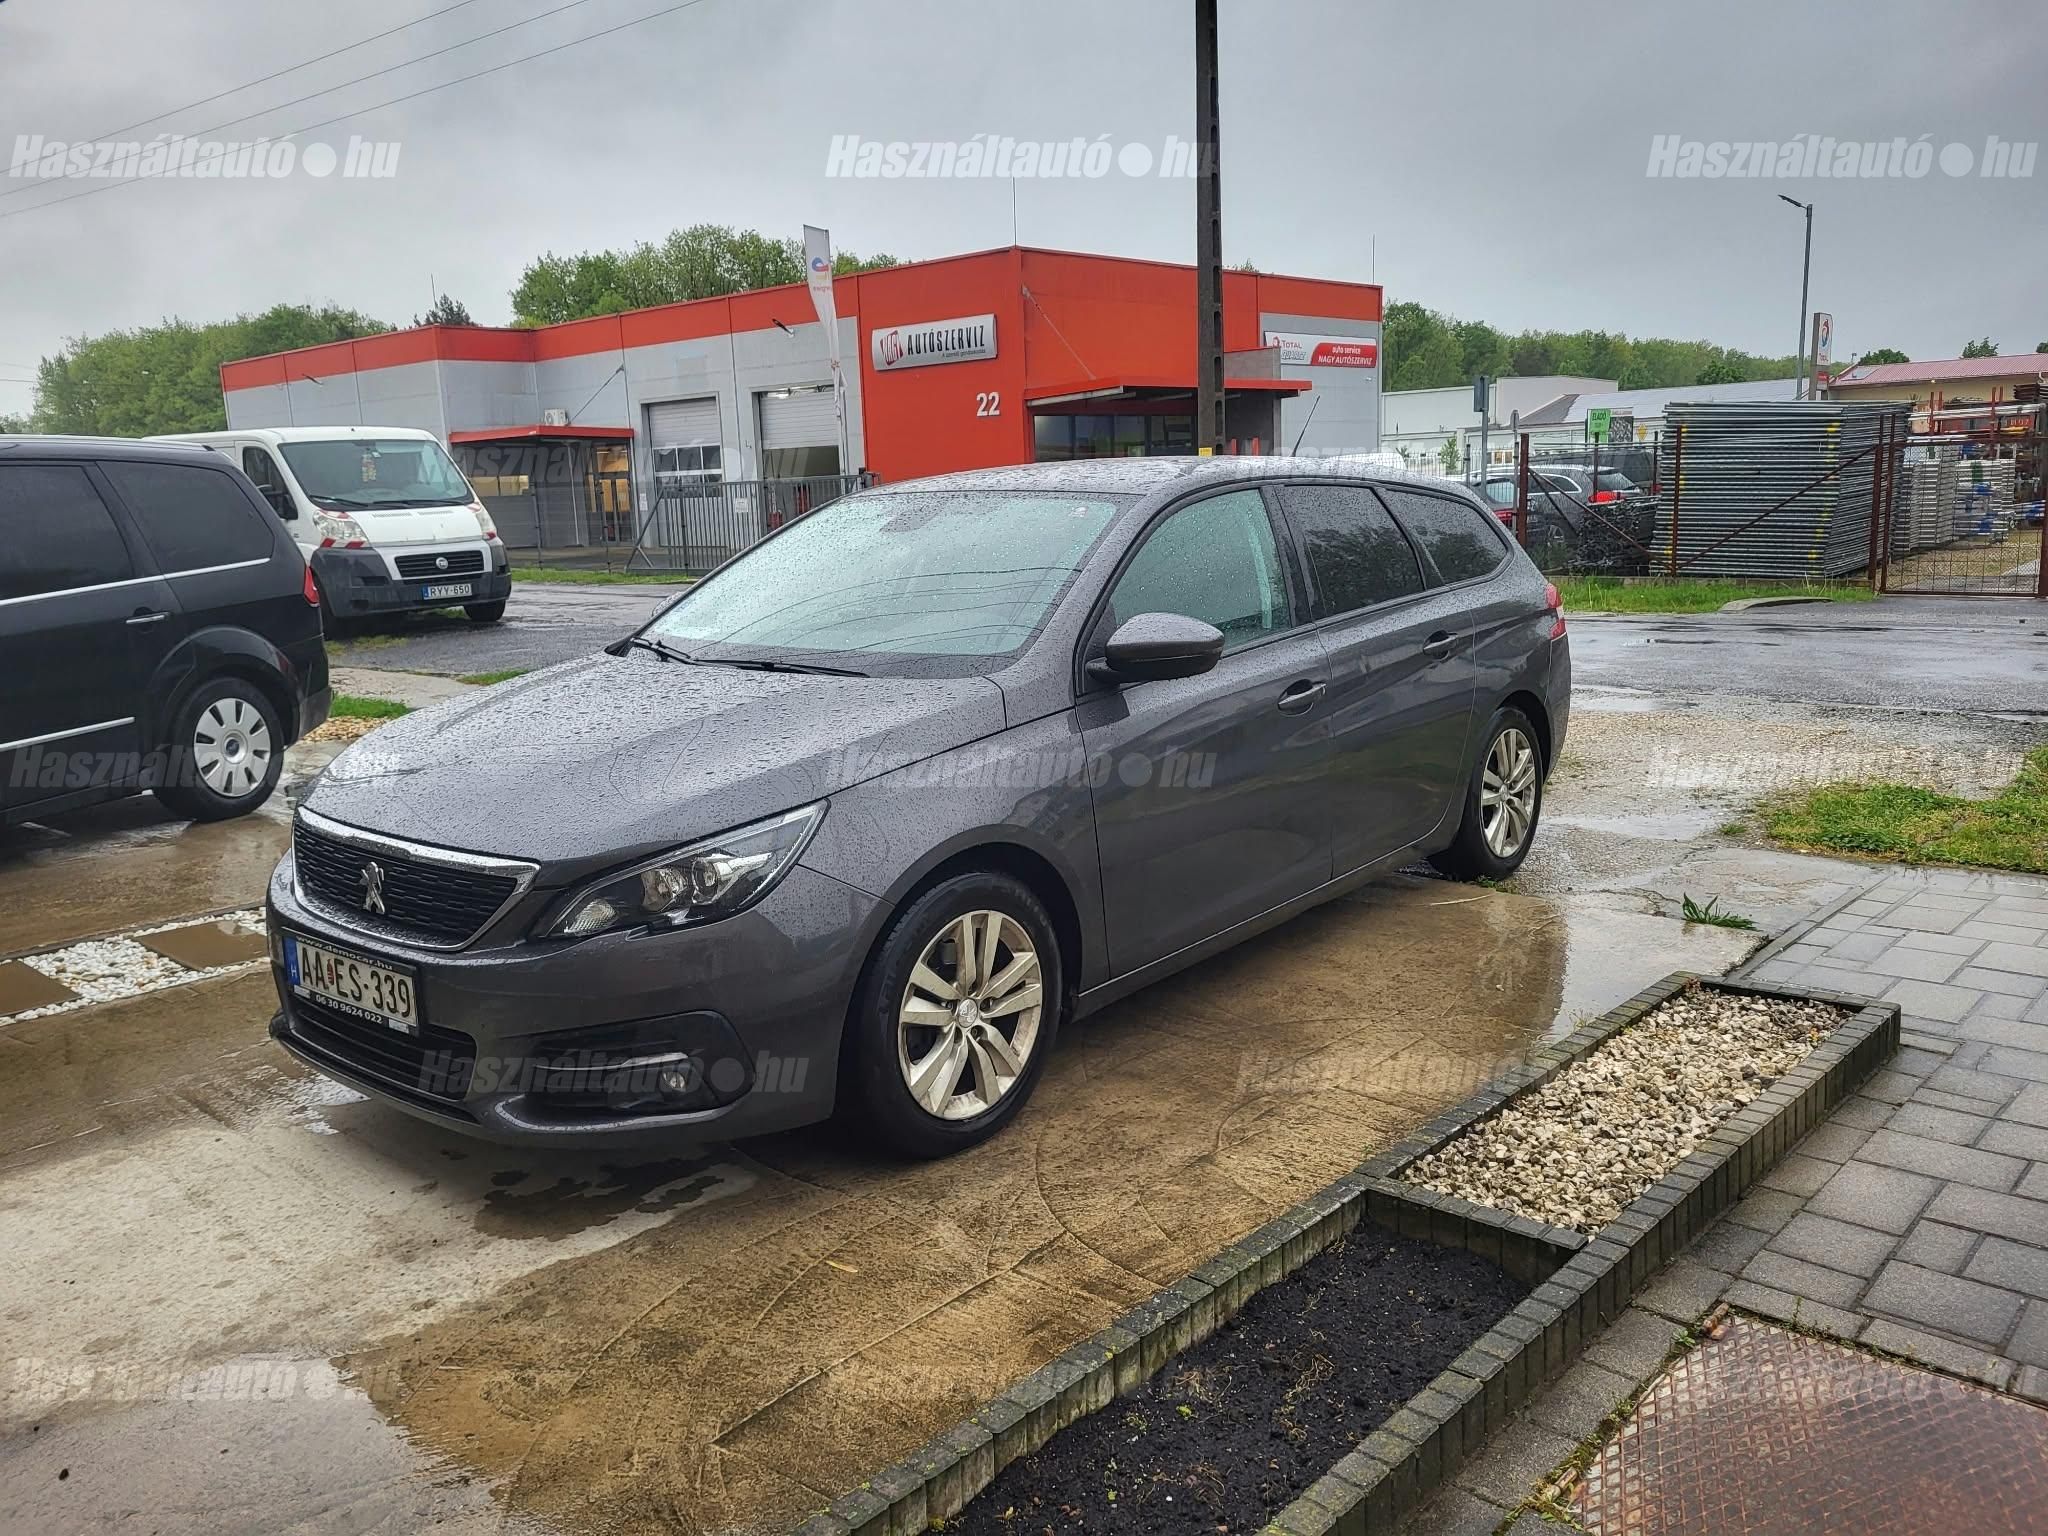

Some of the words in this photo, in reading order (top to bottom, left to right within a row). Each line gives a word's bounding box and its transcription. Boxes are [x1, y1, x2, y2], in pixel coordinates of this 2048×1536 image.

[907, 325, 985, 355] AUTÓSZERVIZ
[976, 392, 1000, 417] 22
[430, 584, 470, 597] RYY-650
[315, 994, 326, 1005] 06
[327, 998, 339, 1010] 30
[340, 1002, 363, 1019] 9624
[364, 1011, 383, 1025] 022
